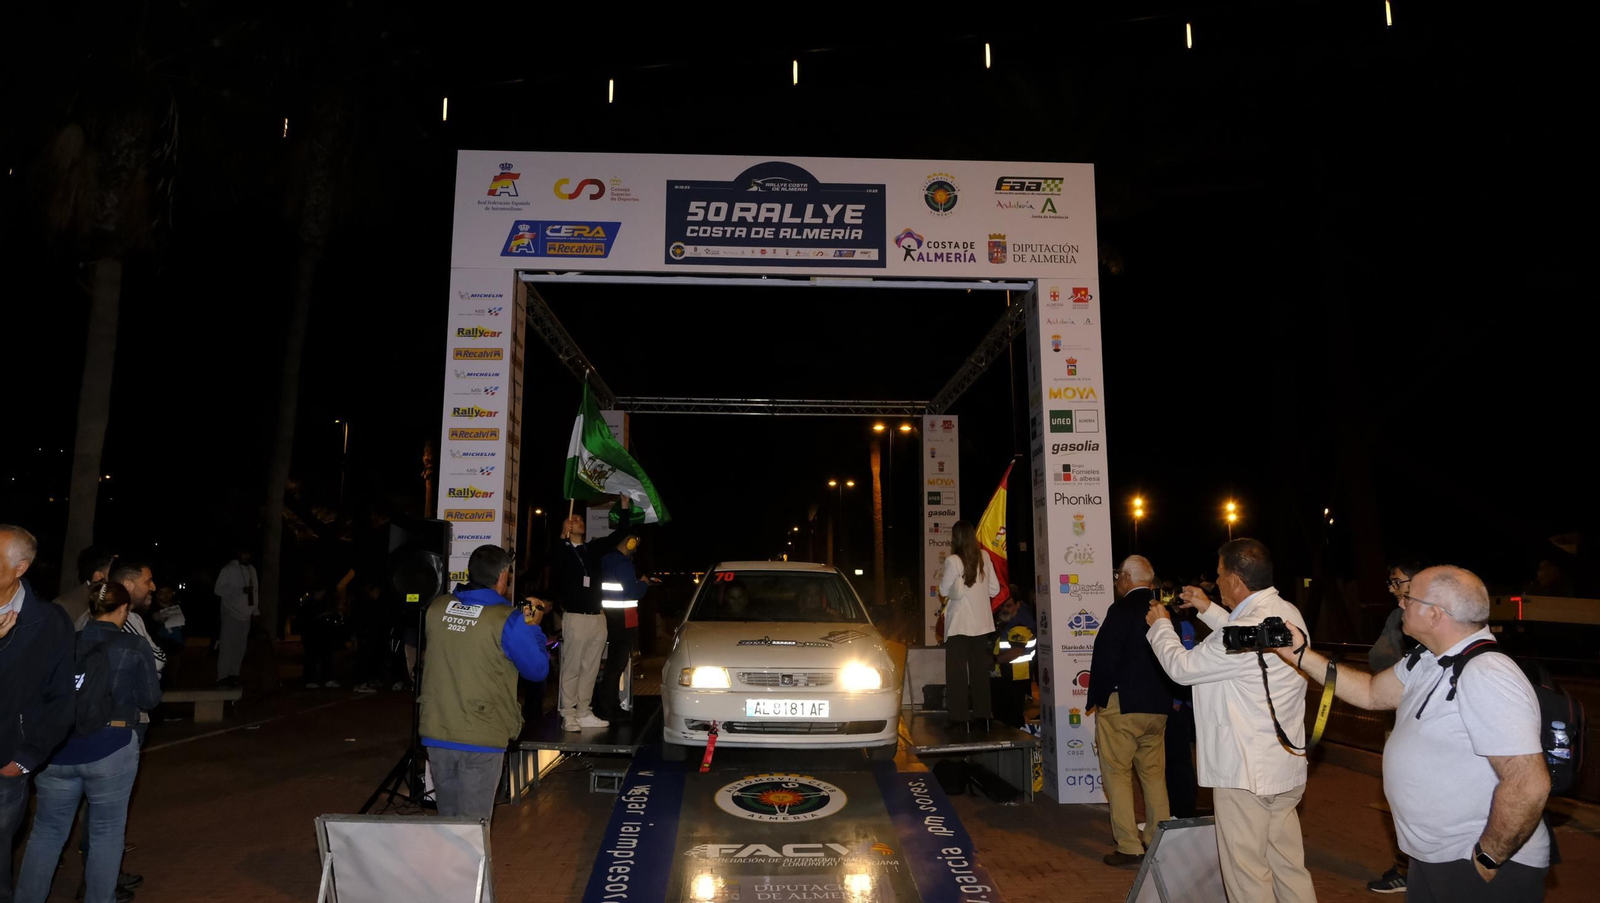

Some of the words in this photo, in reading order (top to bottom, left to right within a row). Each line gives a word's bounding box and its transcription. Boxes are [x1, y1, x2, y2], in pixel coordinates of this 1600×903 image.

[686, 201, 728, 222] 50
[730, 203, 866, 225] RALLYE
[545, 224, 607, 238] CERA
[686, 226, 747, 238] COSTA
[750, 227, 776, 239] DE
[779, 226, 863, 240] ALMERÍA
[557, 244, 595, 254] Recalvi
[926, 240, 962, 250] COSTA
[963, 241, 975, 250] DE
[1012, 242, 1079, 253] DIPUTACIÓN
[917, 250, 977, 263] ALMERÍA
[1013, 254, 1028, 263] DE
[1030, 253, 1077, 264] ALMERÍA
[463, 350, 493, 358] Recalvi
[458, 430, 489, 438] Recalvi
[1051, 440, 1100, 455] gasolia
[1054, 492, 1102, 505] Phonika
[454, 511, 486, 519] Recalvi
[928, 509, 955, 517] gasolia
[714, 572, 734, 582] 70
[442, 615, 478, 627] FOTO/TV
[447, 623, 467, 633] 2025
[754, 702, 770, 715] AL
[772, 702, 805, 716] 8181
[810, 703, 826, 716] AF
[808, 780, 836, 794] CLUB
[746, 813, 819, 822] ALMERIA
